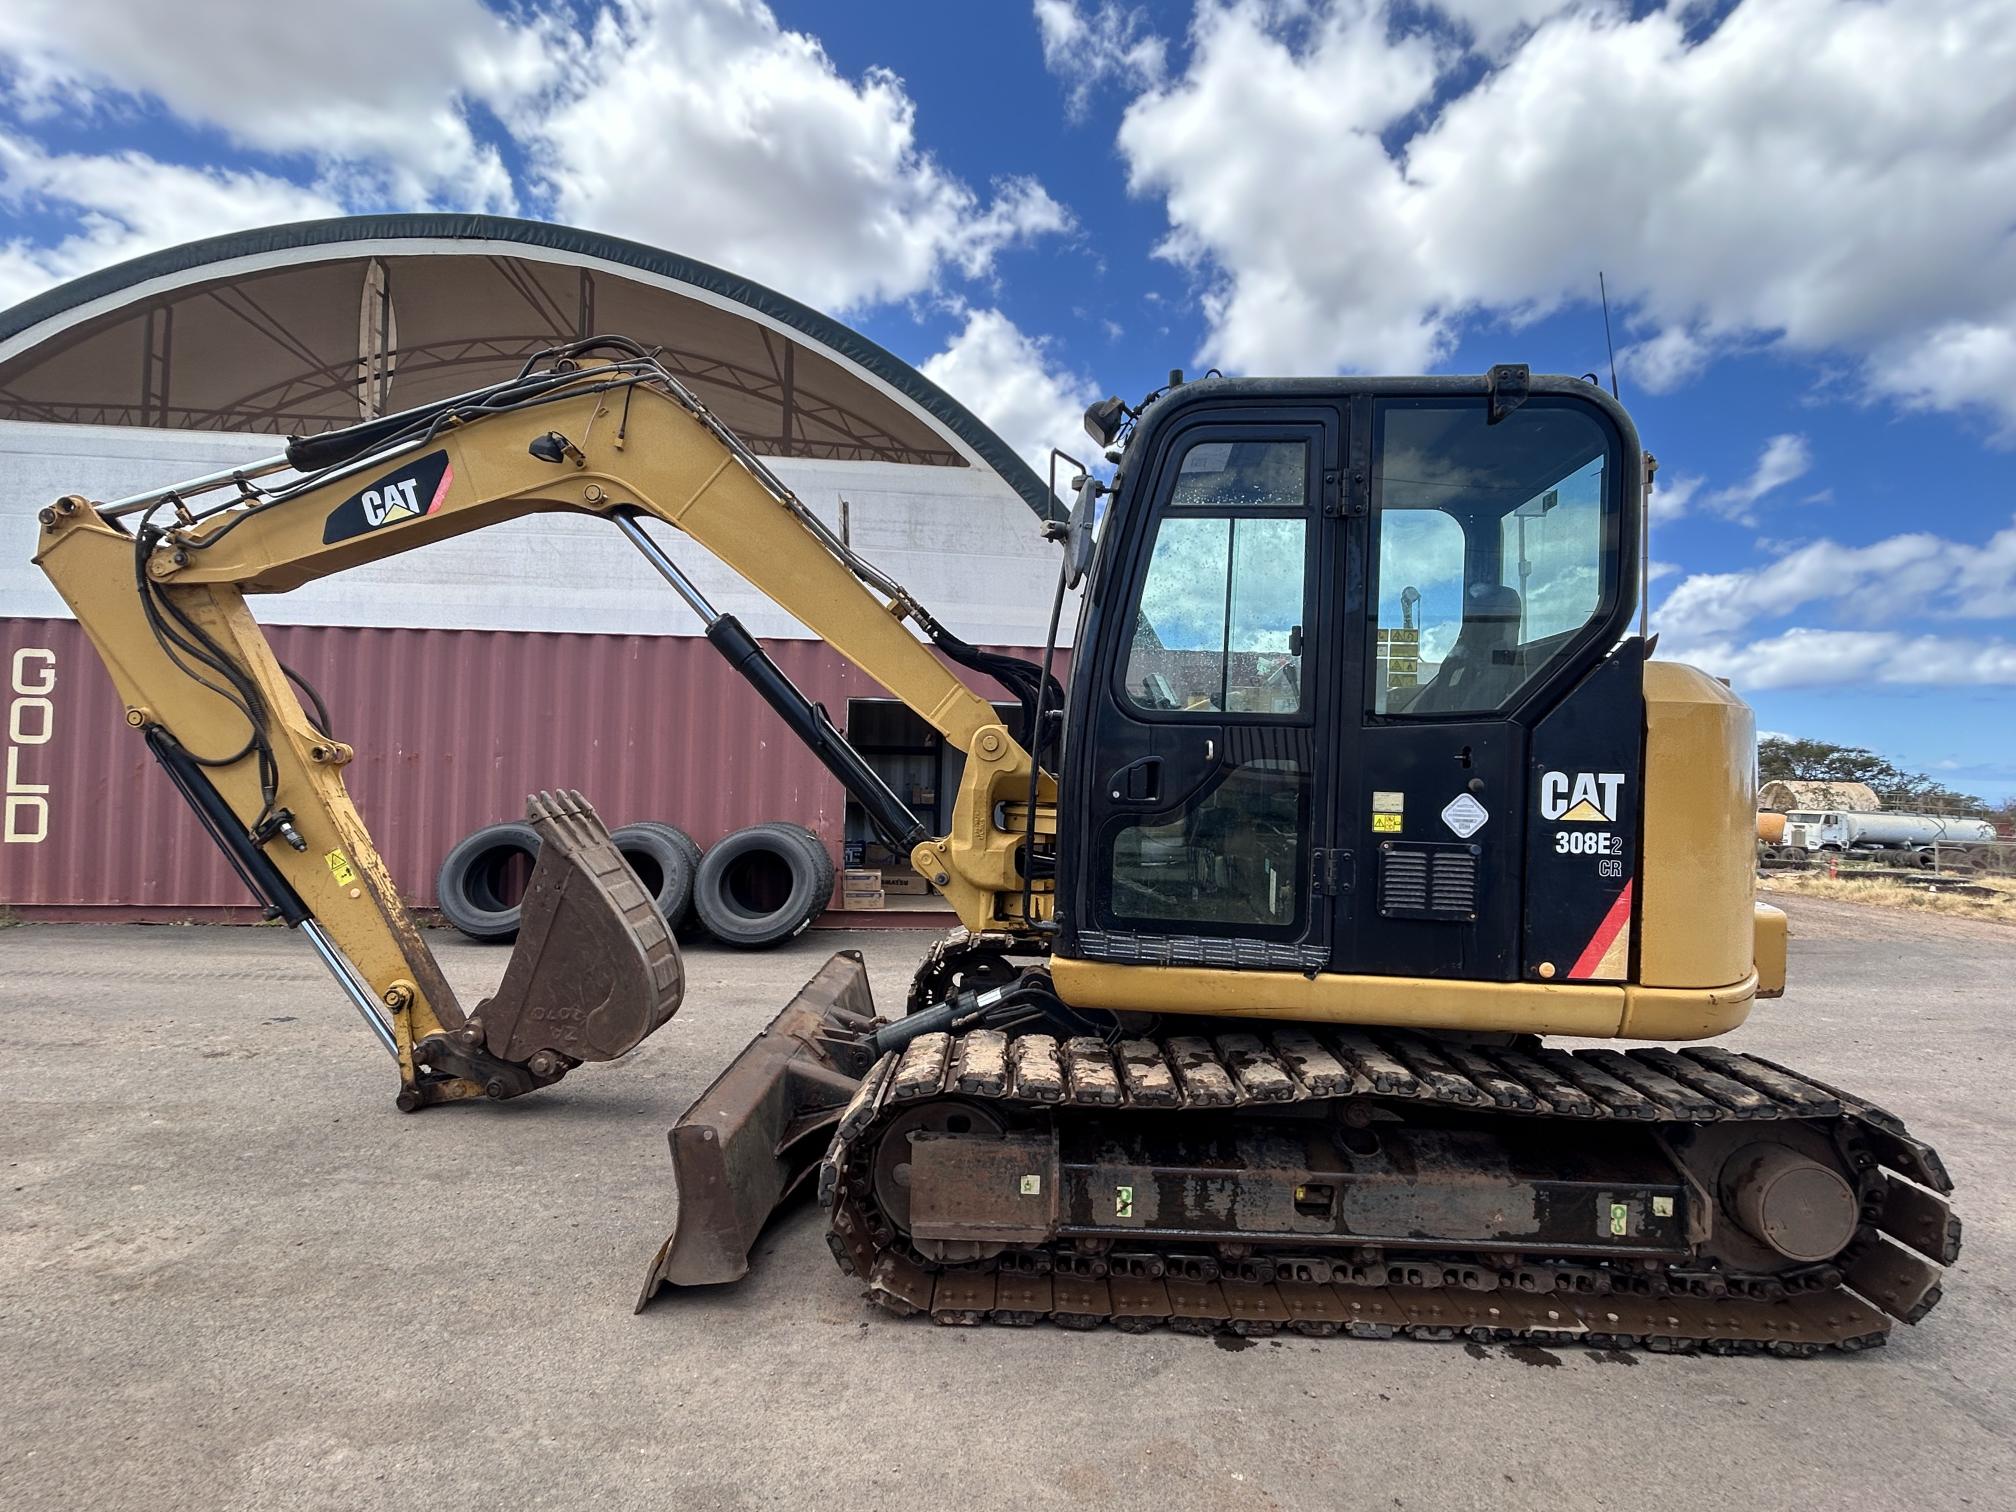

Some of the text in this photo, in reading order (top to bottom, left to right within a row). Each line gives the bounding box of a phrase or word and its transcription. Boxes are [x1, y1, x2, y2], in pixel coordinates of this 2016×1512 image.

[361, 478, 420, 527] CAT
[4, 648, 56, 843] GOLD
[1541, 771, 1625, 821] CAT
[1598, 860, 1622, 877] CR
